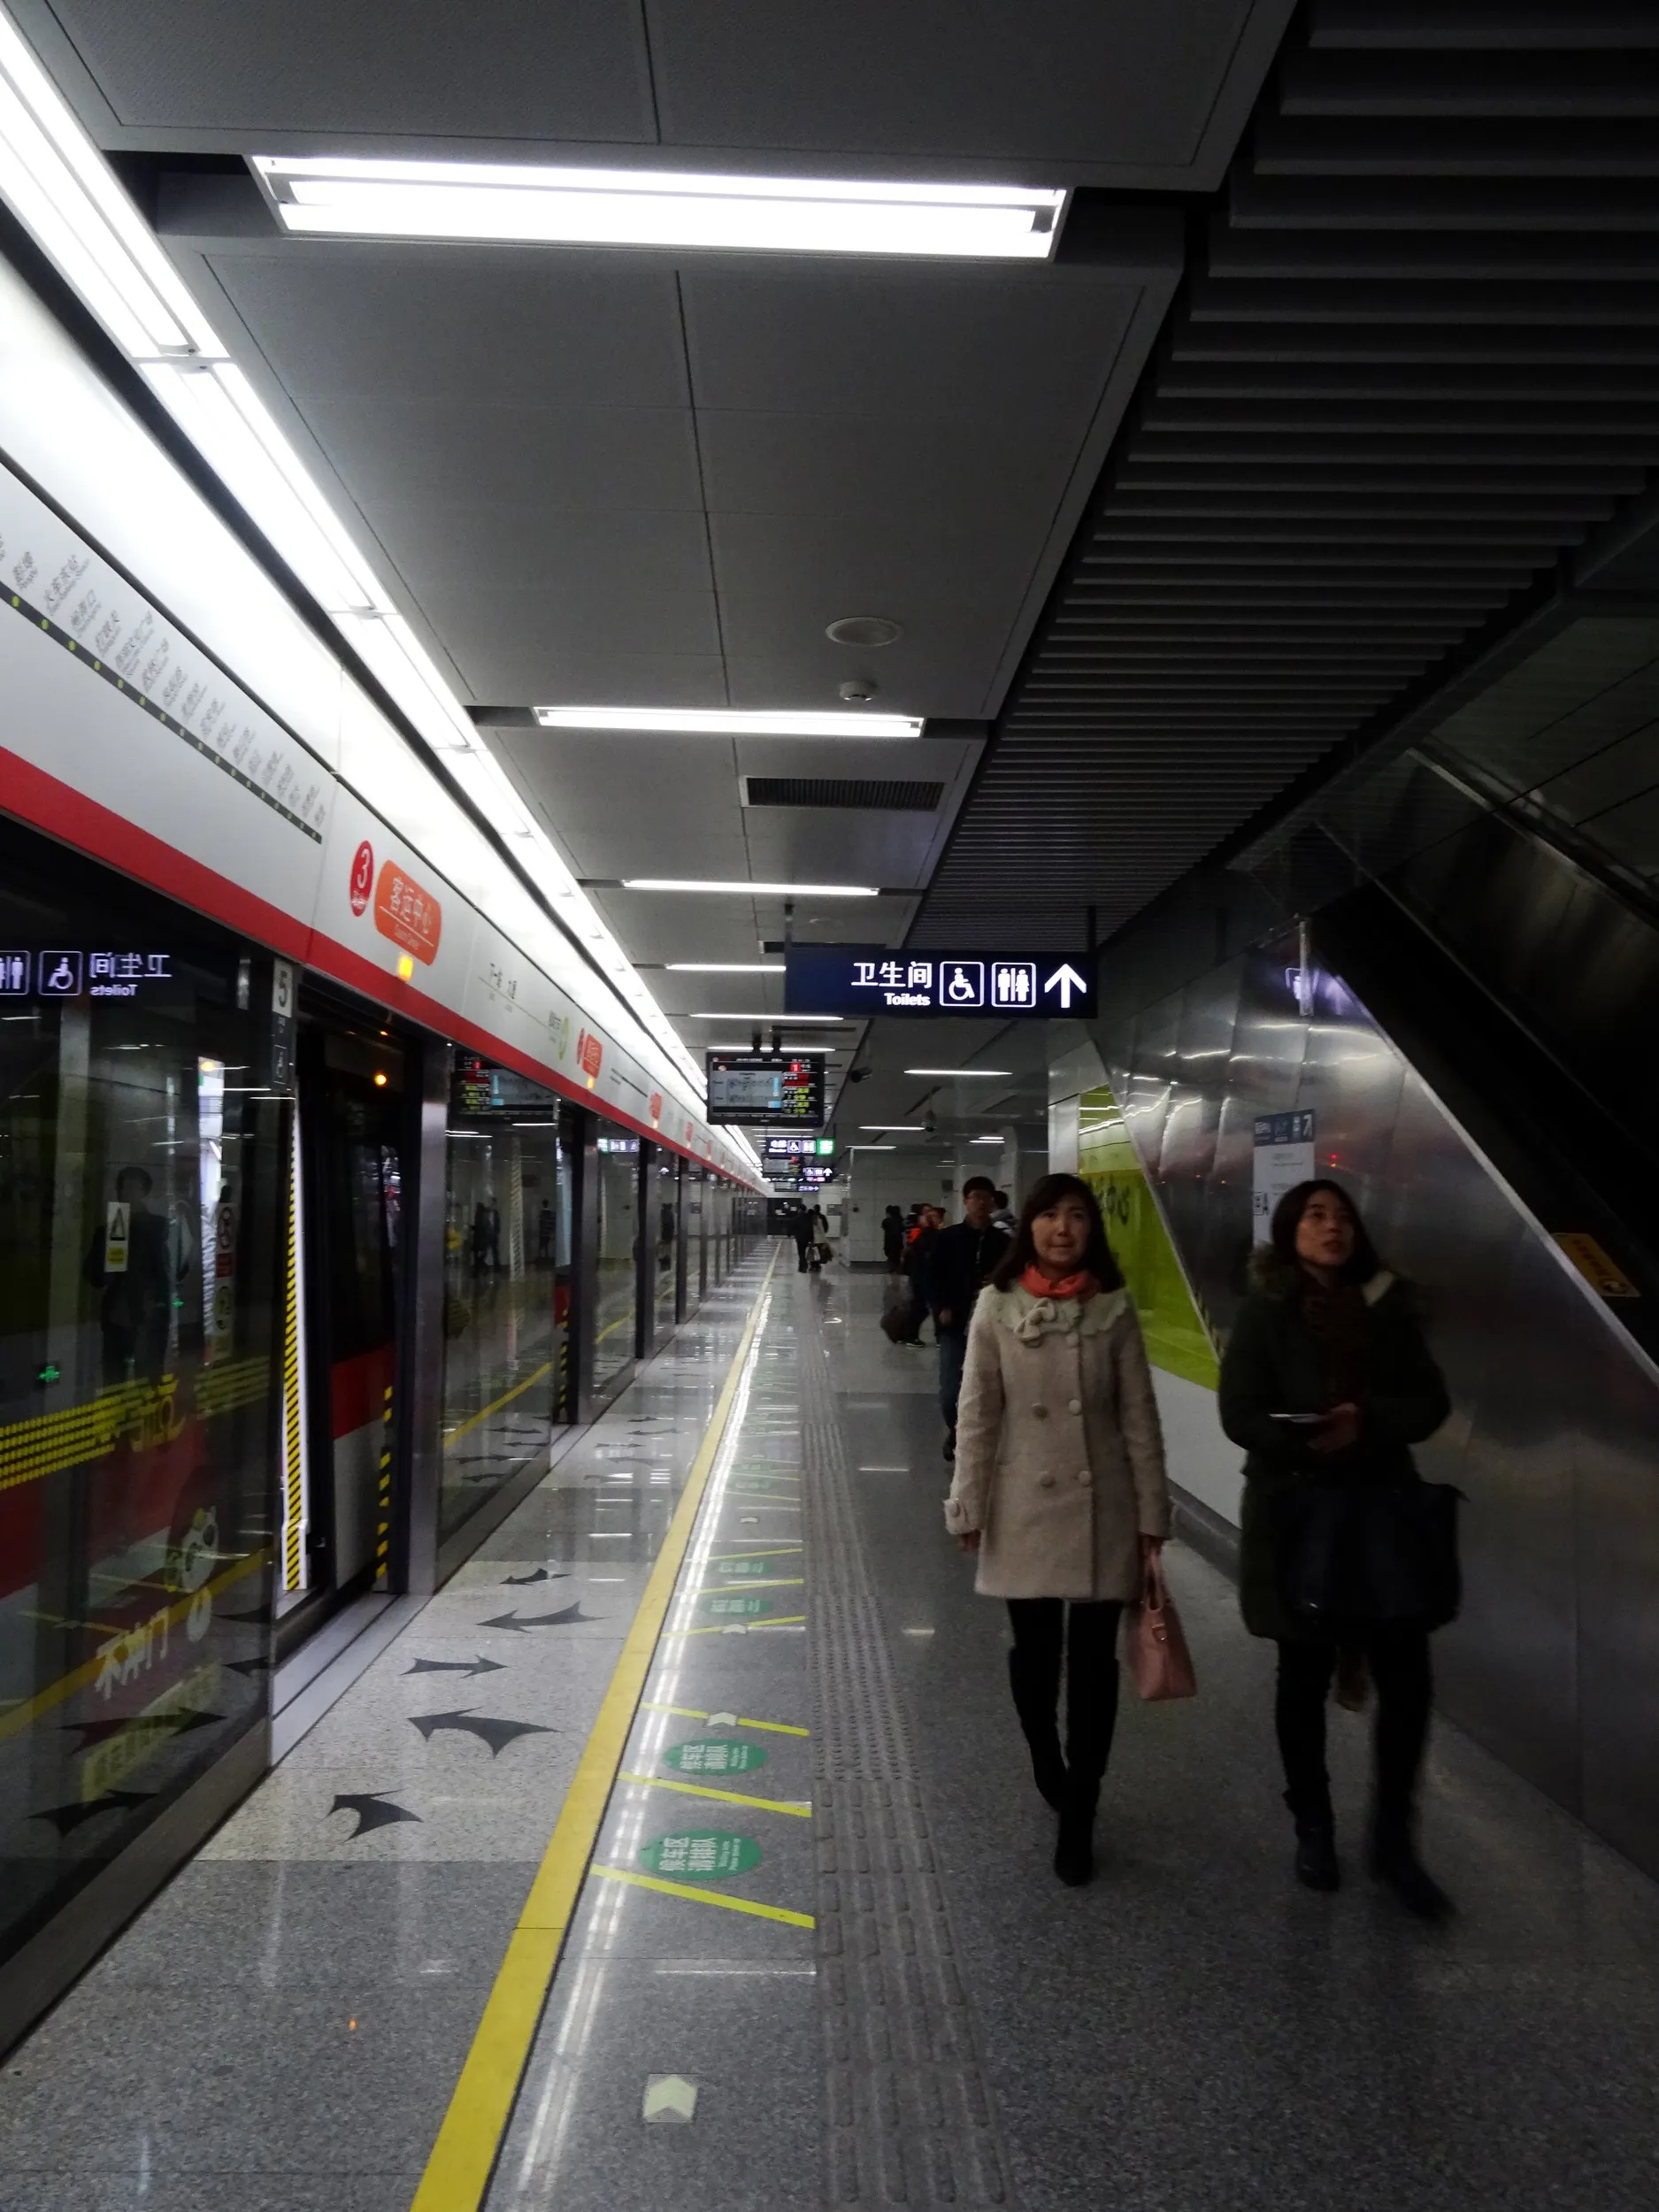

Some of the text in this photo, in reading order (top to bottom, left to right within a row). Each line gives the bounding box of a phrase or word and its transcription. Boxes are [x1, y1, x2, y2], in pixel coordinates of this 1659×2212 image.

[357, 848, 371, 889] 3
[850, 961, 933, 989] 卫生间
[884, 992, 931, 1006] Toilets
[658, 1836, 689, 1871] 候车区
[687, 1837, 718, 1871] 请排队
